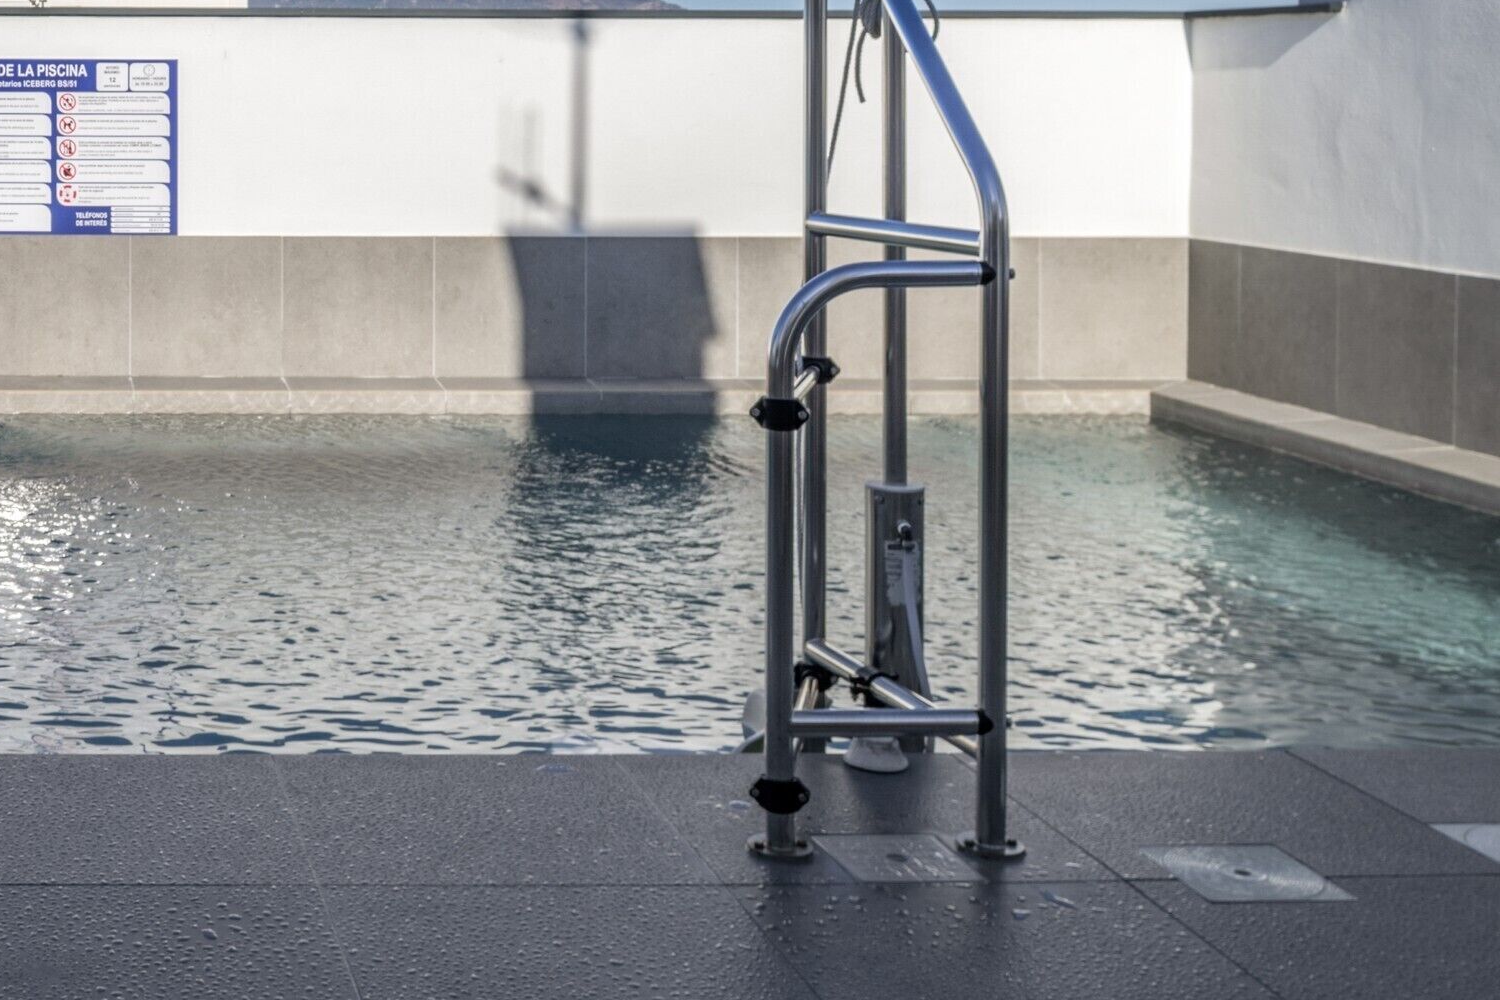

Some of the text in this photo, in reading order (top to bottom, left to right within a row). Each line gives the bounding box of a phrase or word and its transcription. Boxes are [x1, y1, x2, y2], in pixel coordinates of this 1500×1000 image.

[17, 63, 35, 77] LA
[37, 63, 88, 77] PISCINA
[23, 79, 56, 88] ICEBERG
[75, 219, 83, 227] DE
